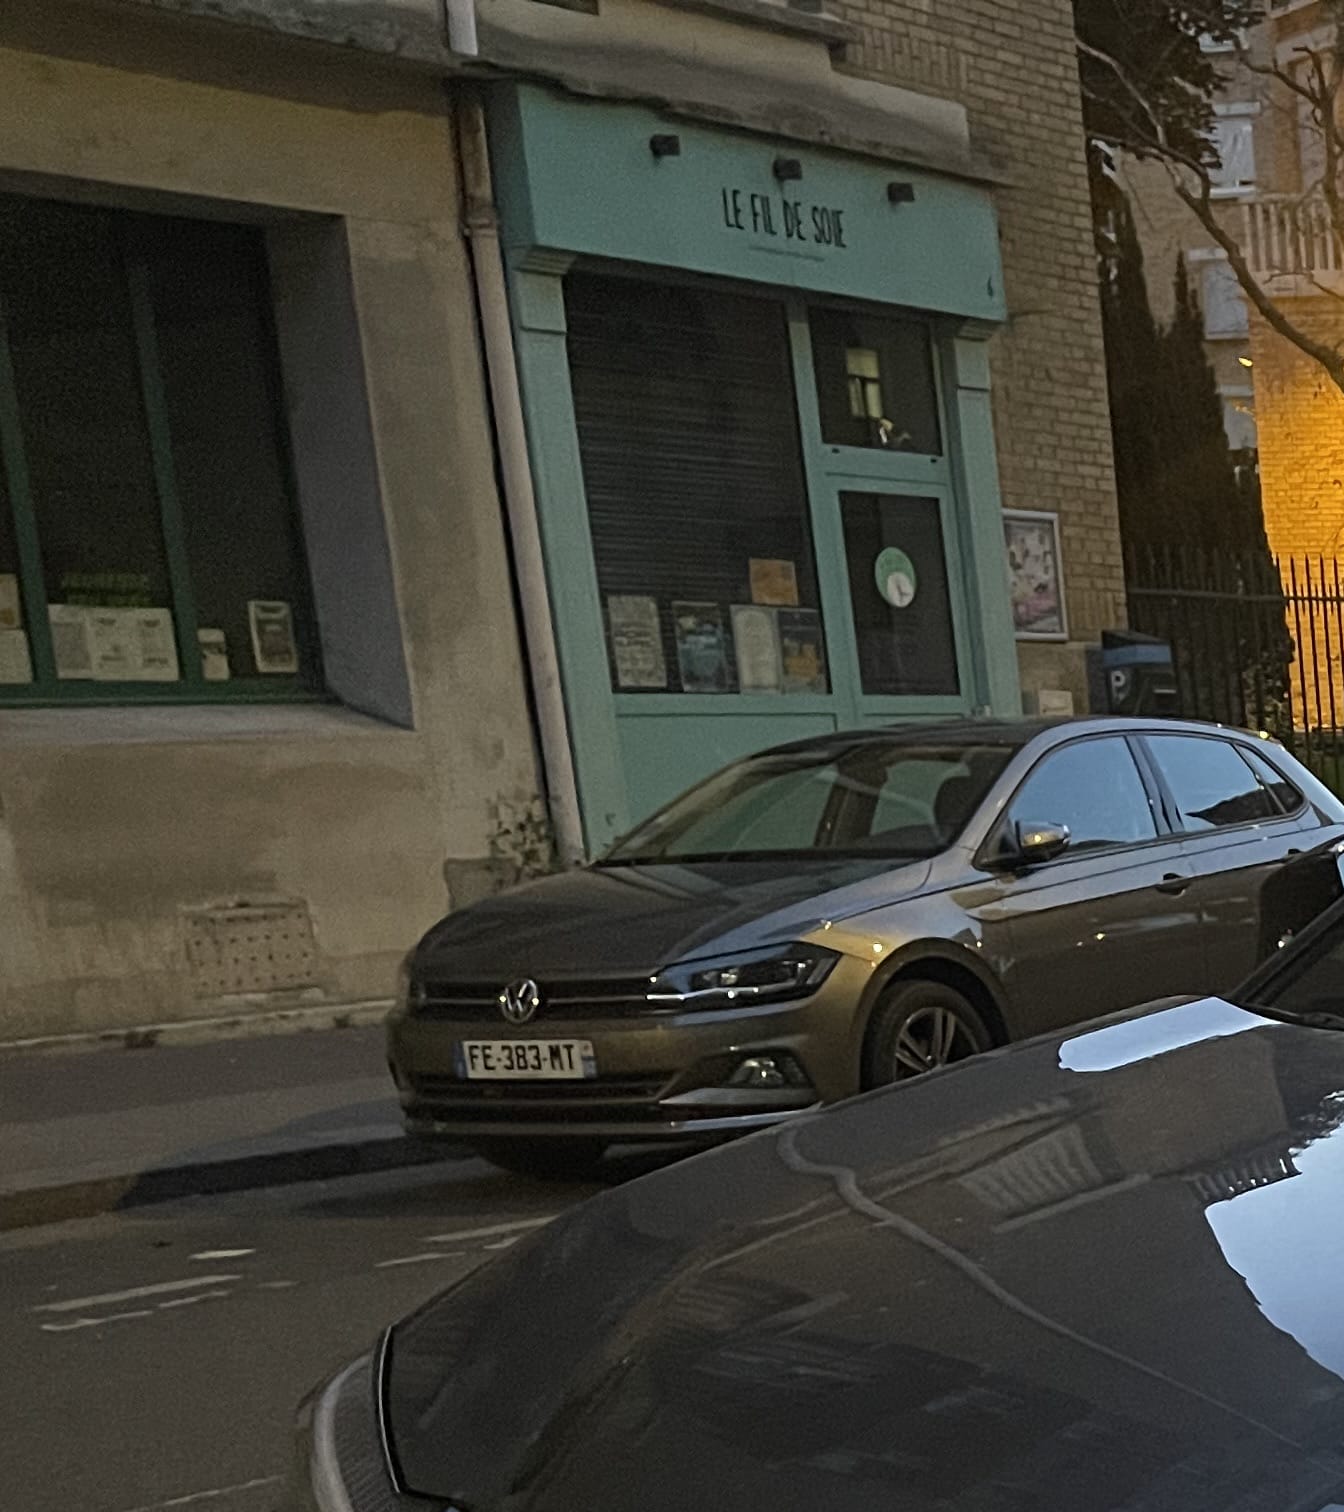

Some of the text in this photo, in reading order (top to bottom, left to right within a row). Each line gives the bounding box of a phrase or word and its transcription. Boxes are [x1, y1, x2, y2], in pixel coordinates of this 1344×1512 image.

[722, 188, 847, 248] LE FIL DE SOIE
